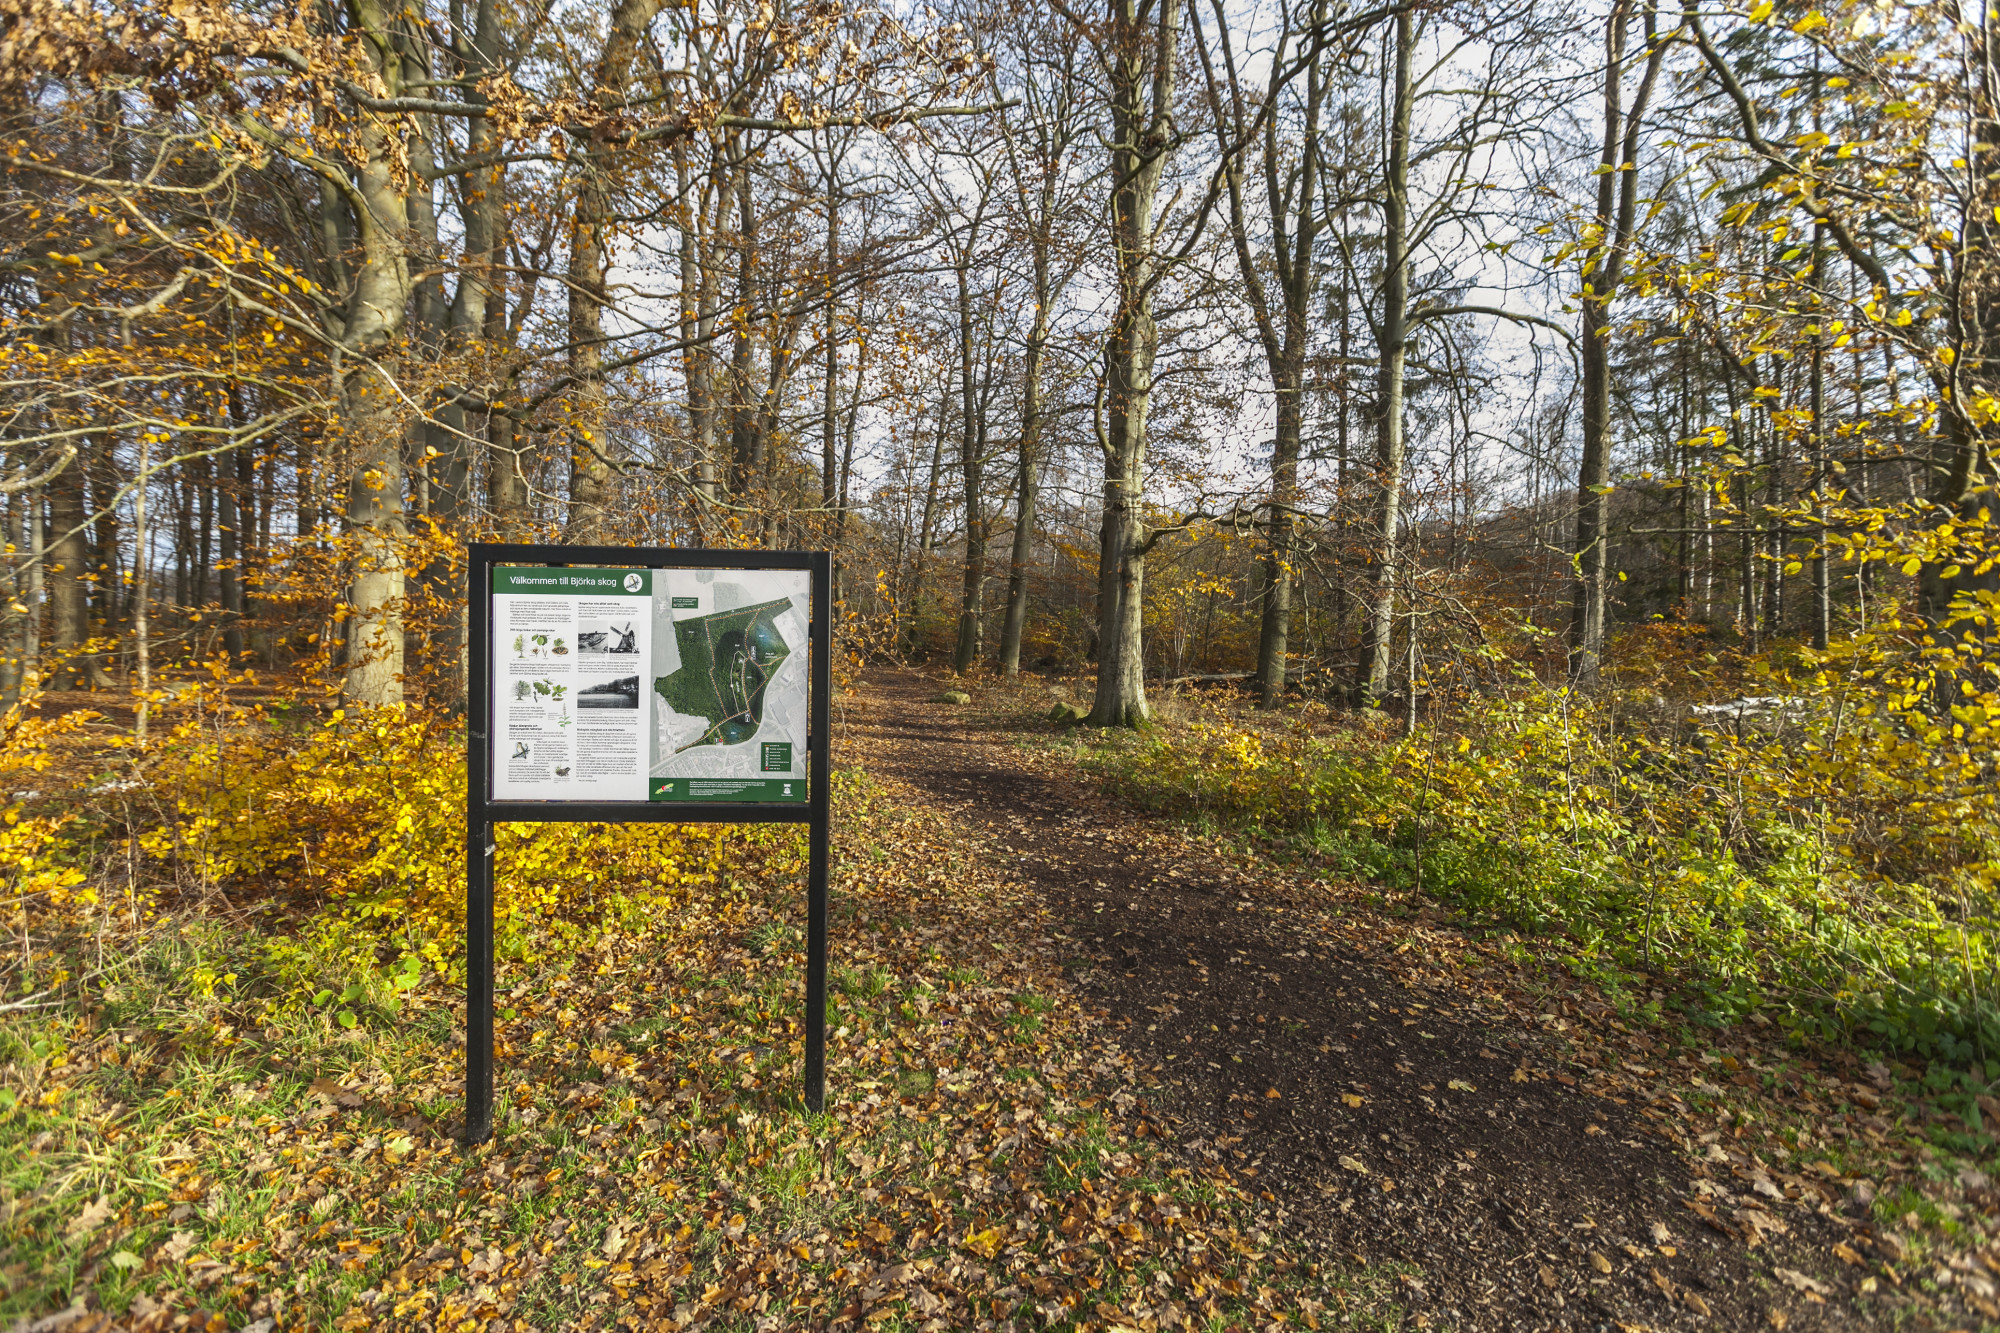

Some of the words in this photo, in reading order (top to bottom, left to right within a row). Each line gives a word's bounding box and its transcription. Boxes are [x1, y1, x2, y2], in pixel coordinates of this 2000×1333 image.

[510, 576, 557, 585] Välkommen
[559, 577, 568, 585] till
[570, 577, 595, 587] Björka
[597, 577, 617, 587] skog
